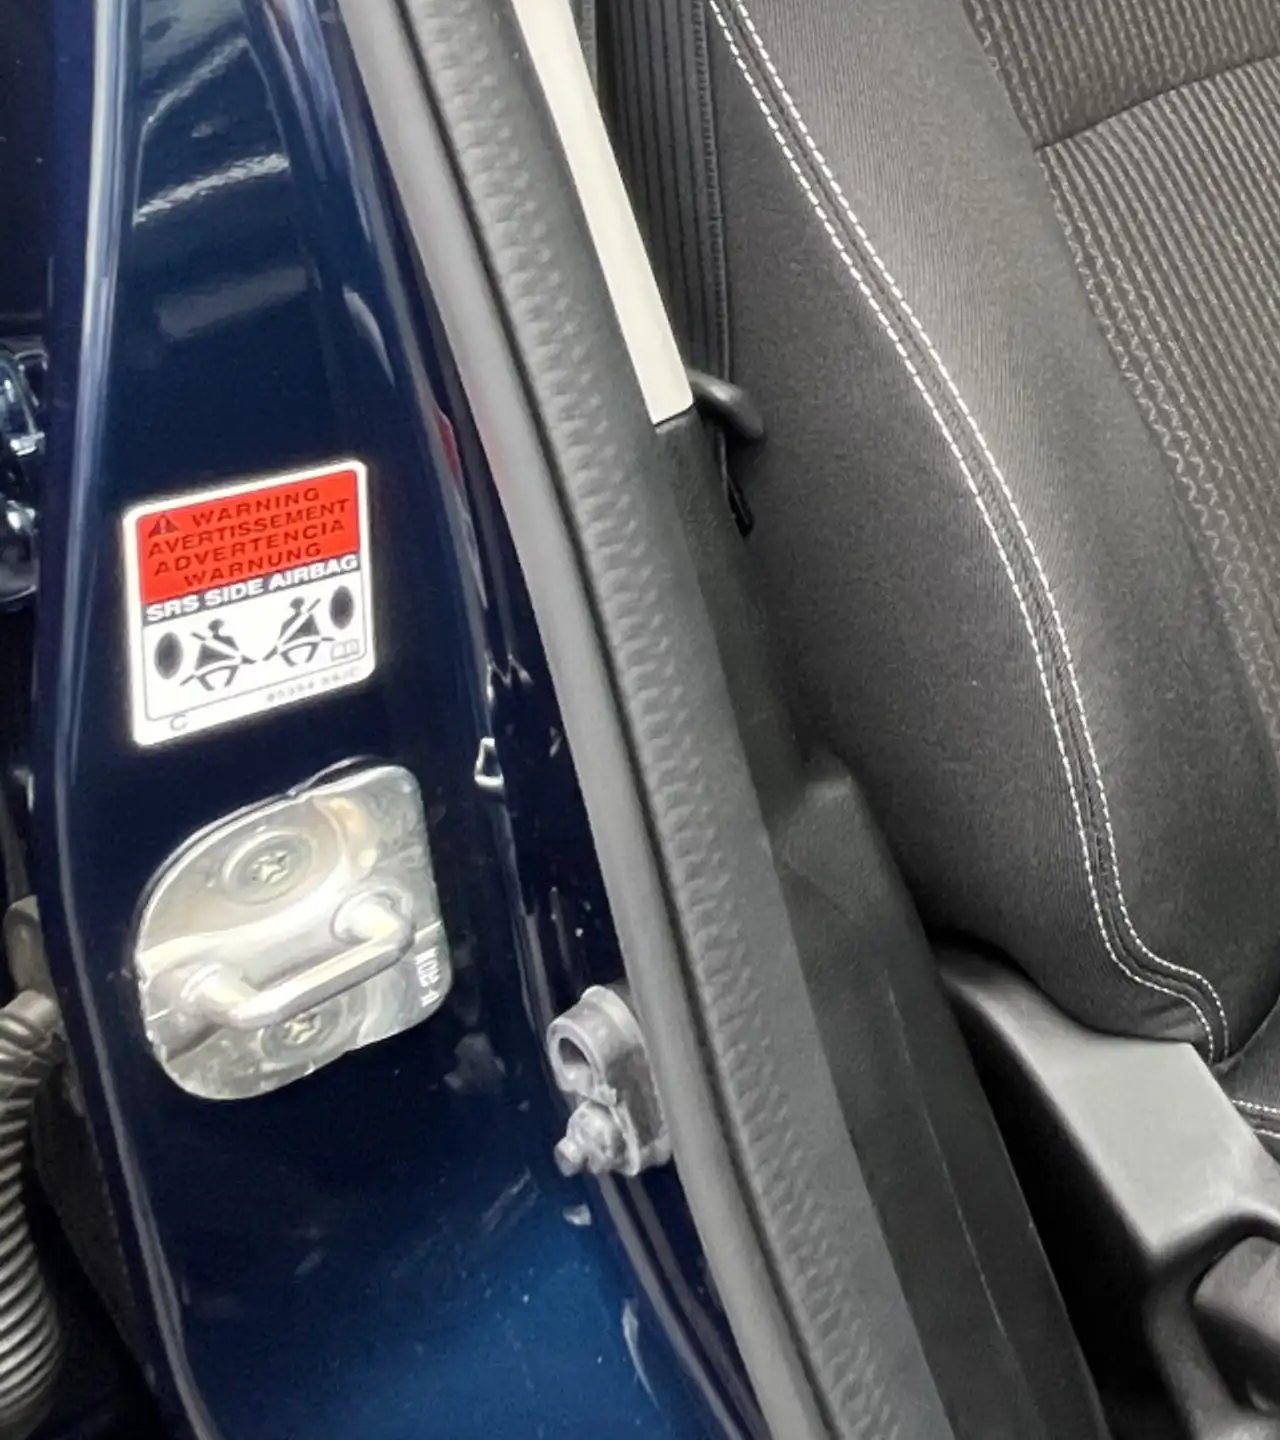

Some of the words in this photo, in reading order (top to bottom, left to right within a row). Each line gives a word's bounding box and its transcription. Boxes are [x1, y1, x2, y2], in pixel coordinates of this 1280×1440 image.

[147, 498, 350, 558] AVERTISSEMENT
[191, 487, 320, 527] WARNING
[154, 520, 345, 576] ADVERTENCIA
[183, 542, 321, 587] WARNUNG
[146, 594, 200, 622] SRS
[204, 577, 266, 606] SIDE
[269, 554, 359, 591] AIRBAG
